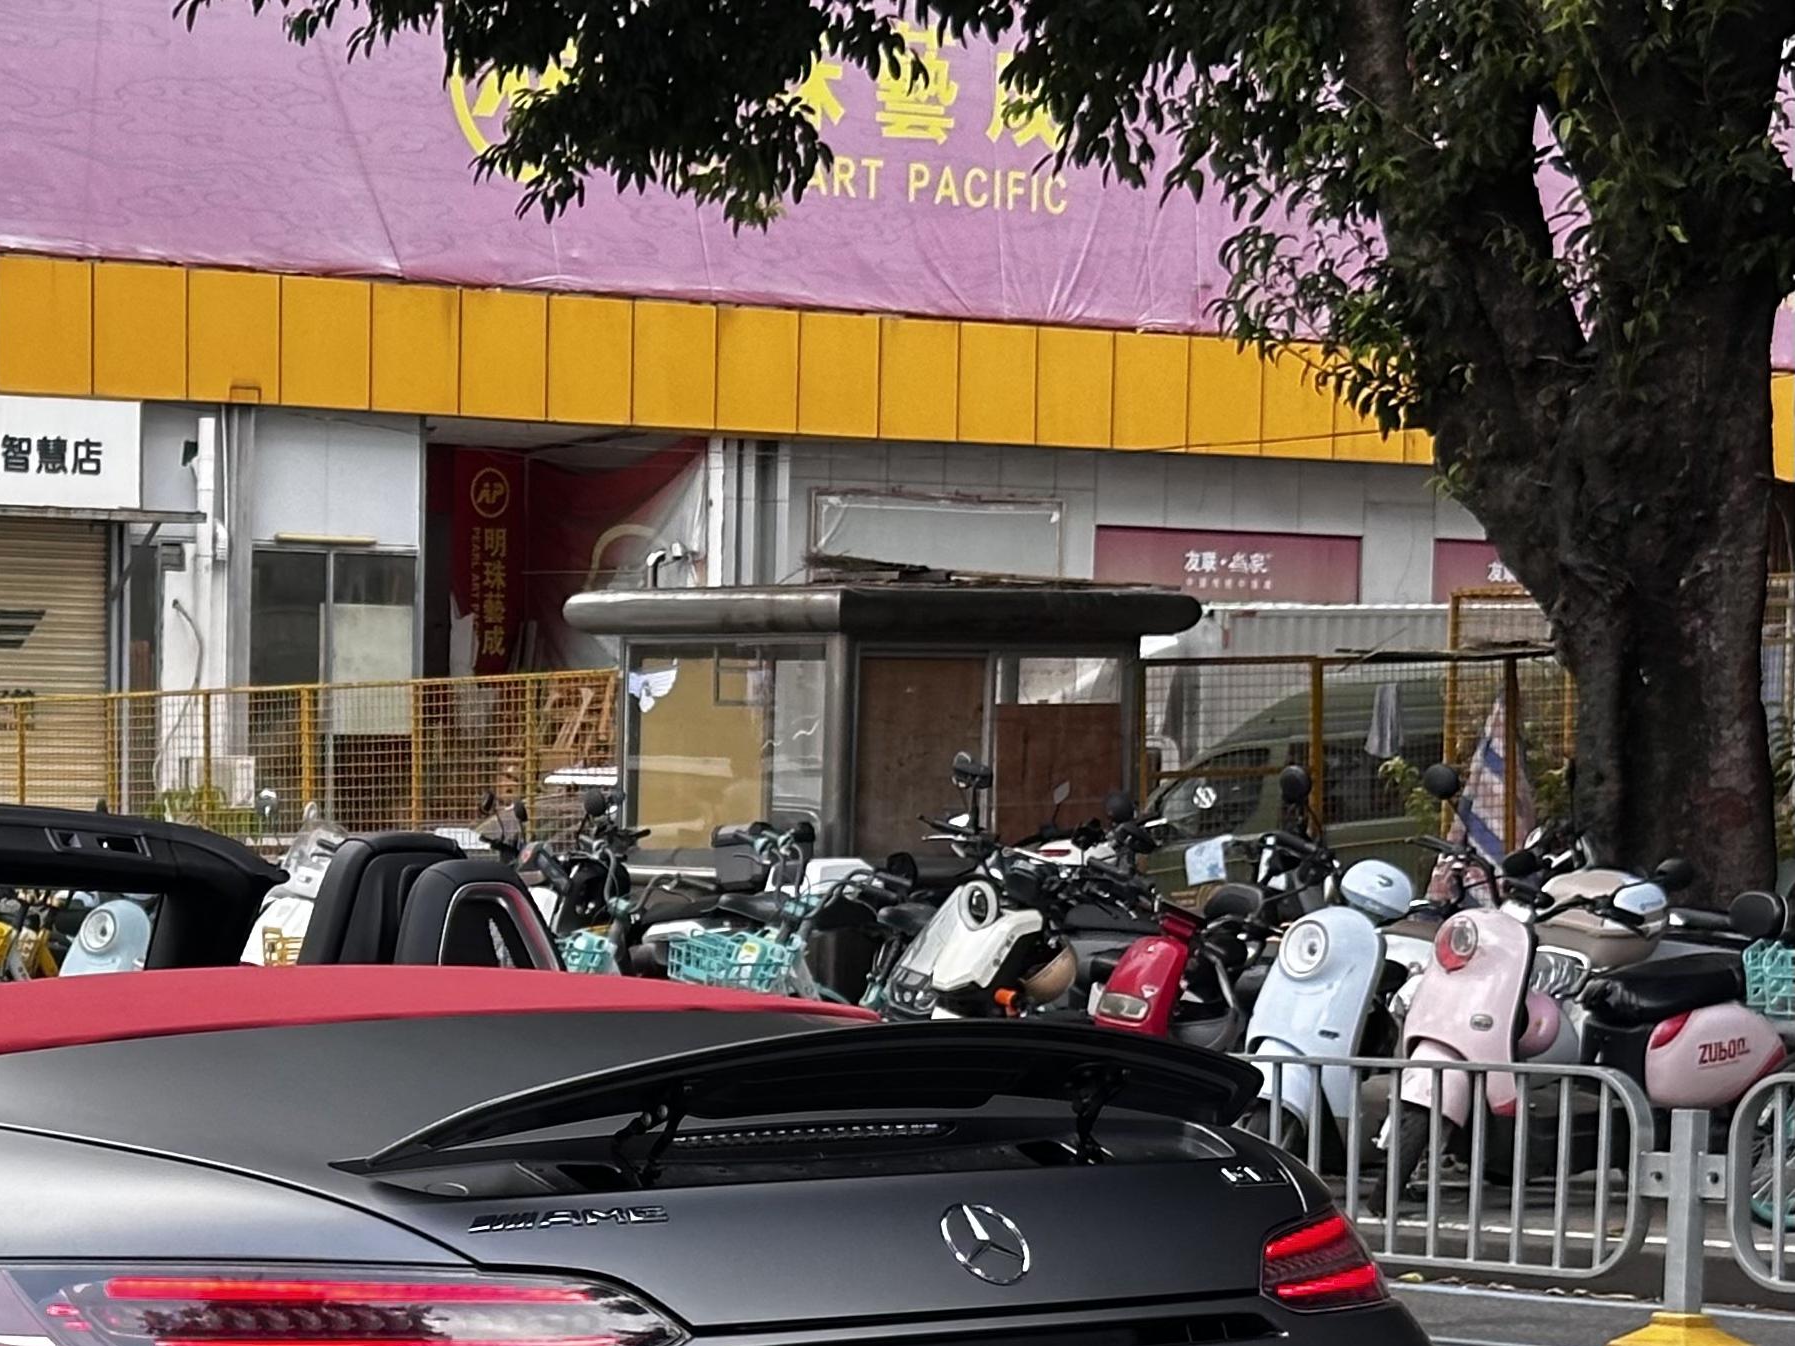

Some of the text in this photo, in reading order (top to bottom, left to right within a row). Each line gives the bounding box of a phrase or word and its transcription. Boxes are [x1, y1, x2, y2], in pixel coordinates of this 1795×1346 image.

[804, 156, 1067, 214] ART PACIFIC
[482, 527, 507, 657] 明珠藝成
